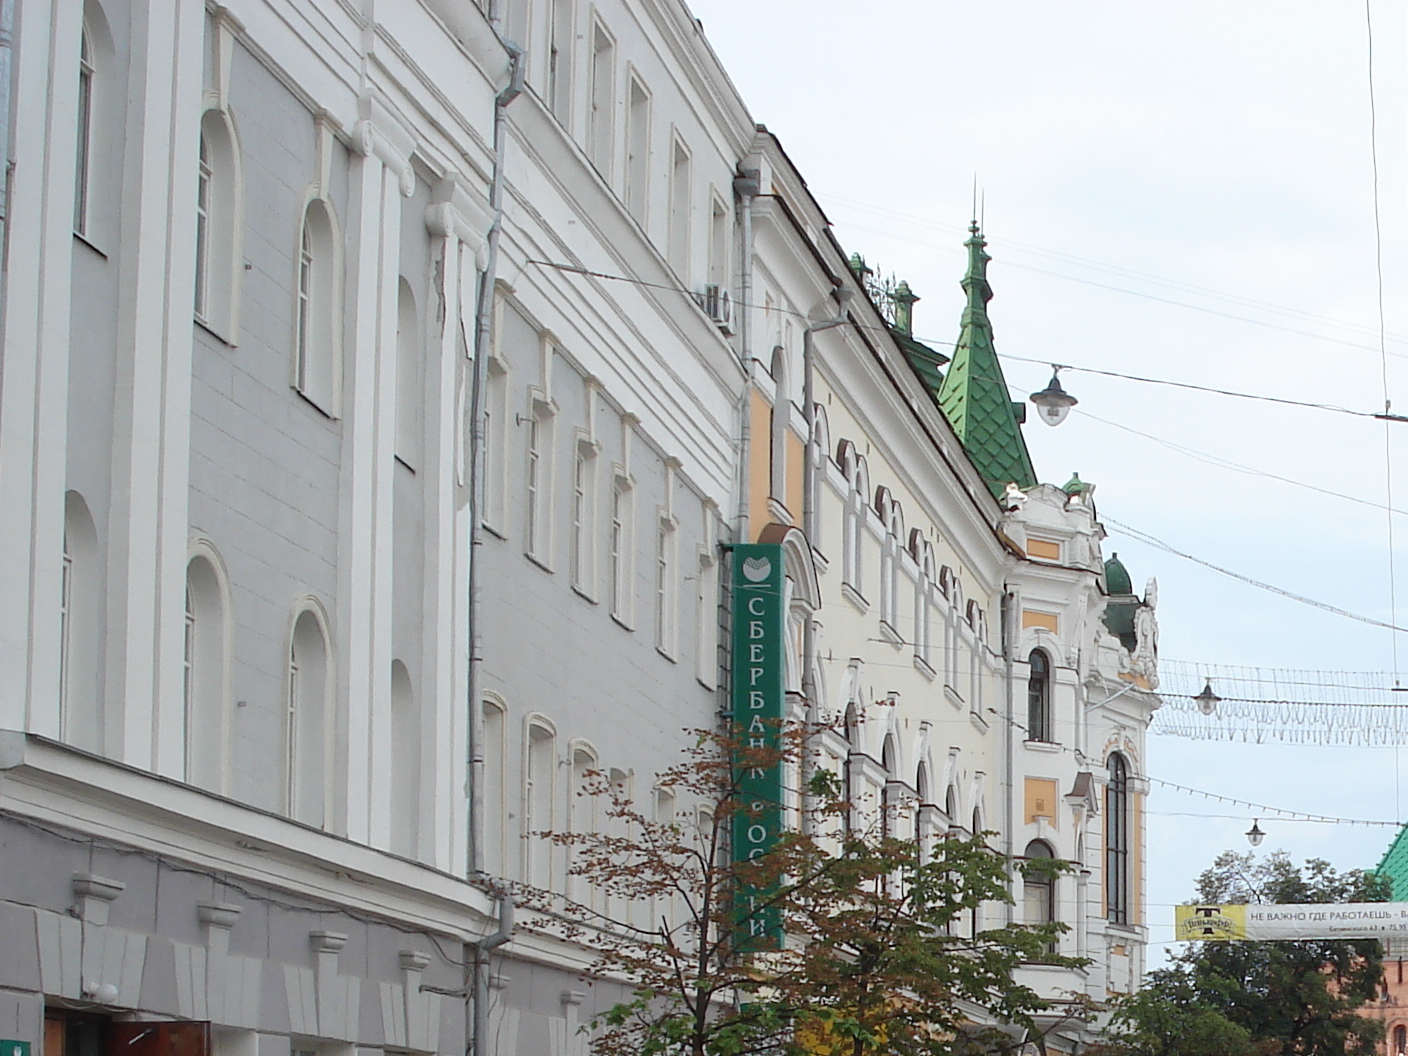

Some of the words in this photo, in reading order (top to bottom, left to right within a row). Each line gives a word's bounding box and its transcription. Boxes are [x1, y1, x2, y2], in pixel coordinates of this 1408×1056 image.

[748, 597, 766, 780] СБЕРБАНК
[747, 801, 767, 938] РОСИИ
[1250, 913, 1264, 921] НЕ
[1267, 913, 1306, 921] ВАЖНО
[1309, 912, 1327, 922] ГДЕ
[1329, 911, 1392, 921] РАБОТАЕШЬ
